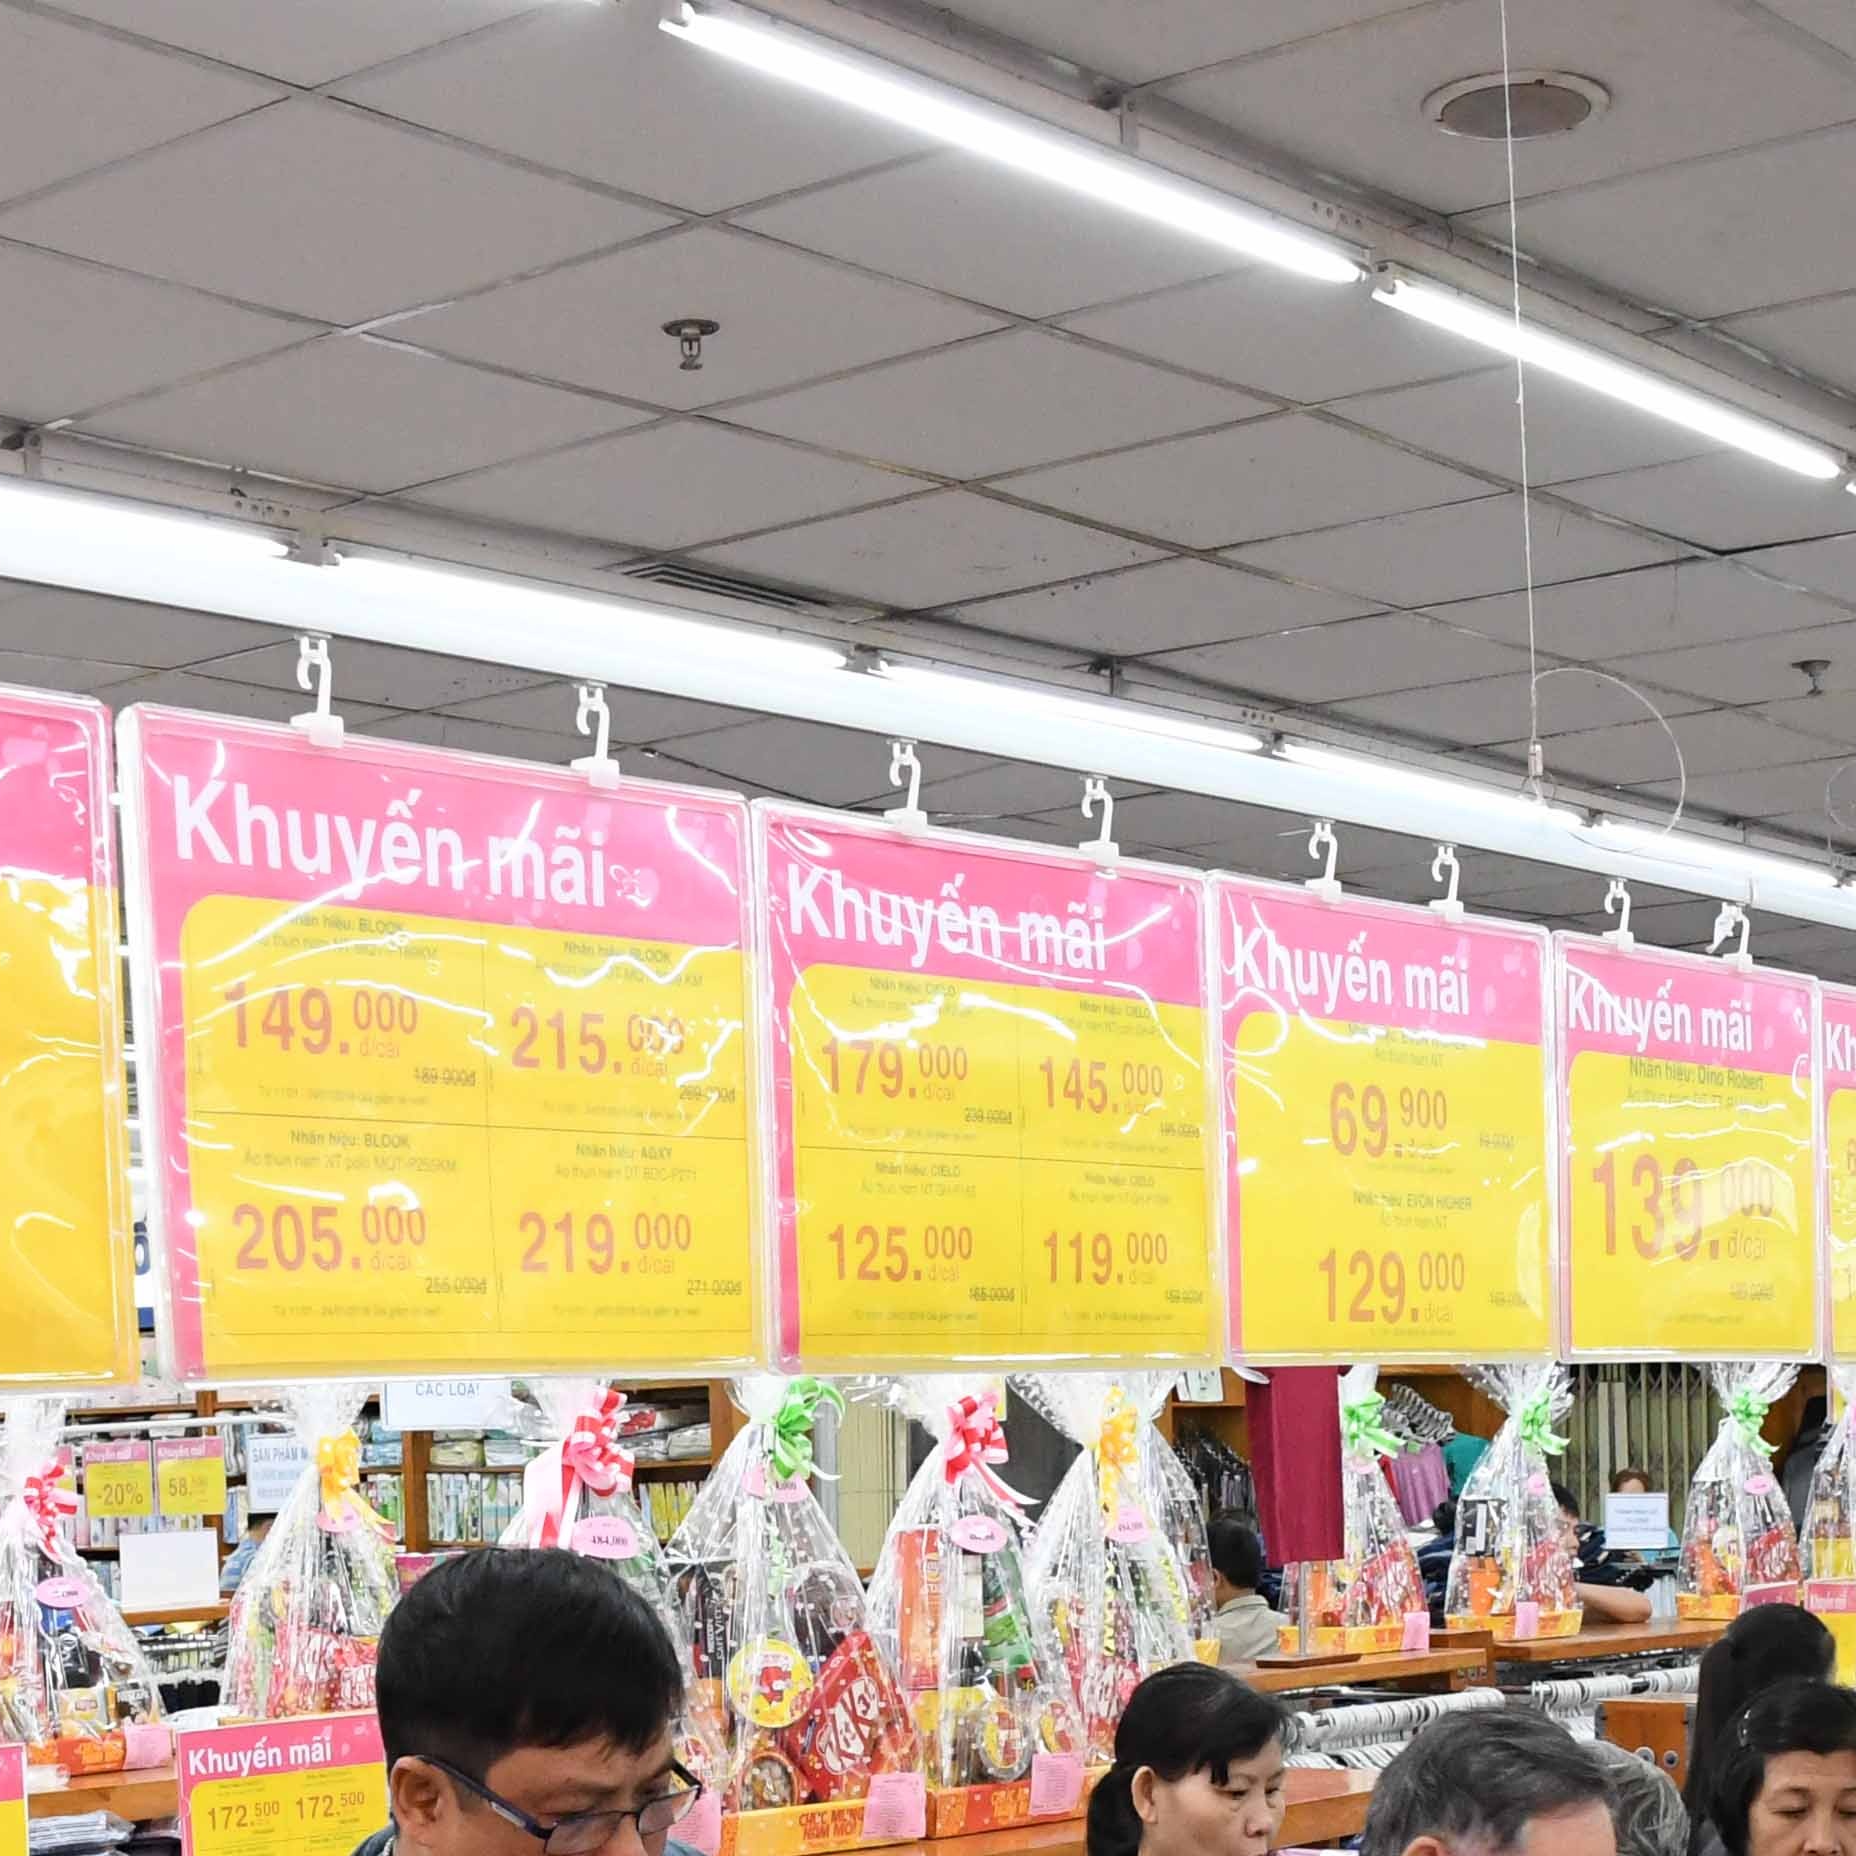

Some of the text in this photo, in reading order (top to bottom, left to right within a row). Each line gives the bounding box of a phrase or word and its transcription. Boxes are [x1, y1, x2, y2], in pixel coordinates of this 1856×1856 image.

[171, 772, 607, 908] Khuyến mãi
[785, 863, 1107, 971] Khuyến mãi
[1234, 928, 1470, 1016] Khuyến mãi
[1568, 971, 1754, 1053] Khuyến mãi
[187, 1735, 332, 1777] Khuyến mãi
